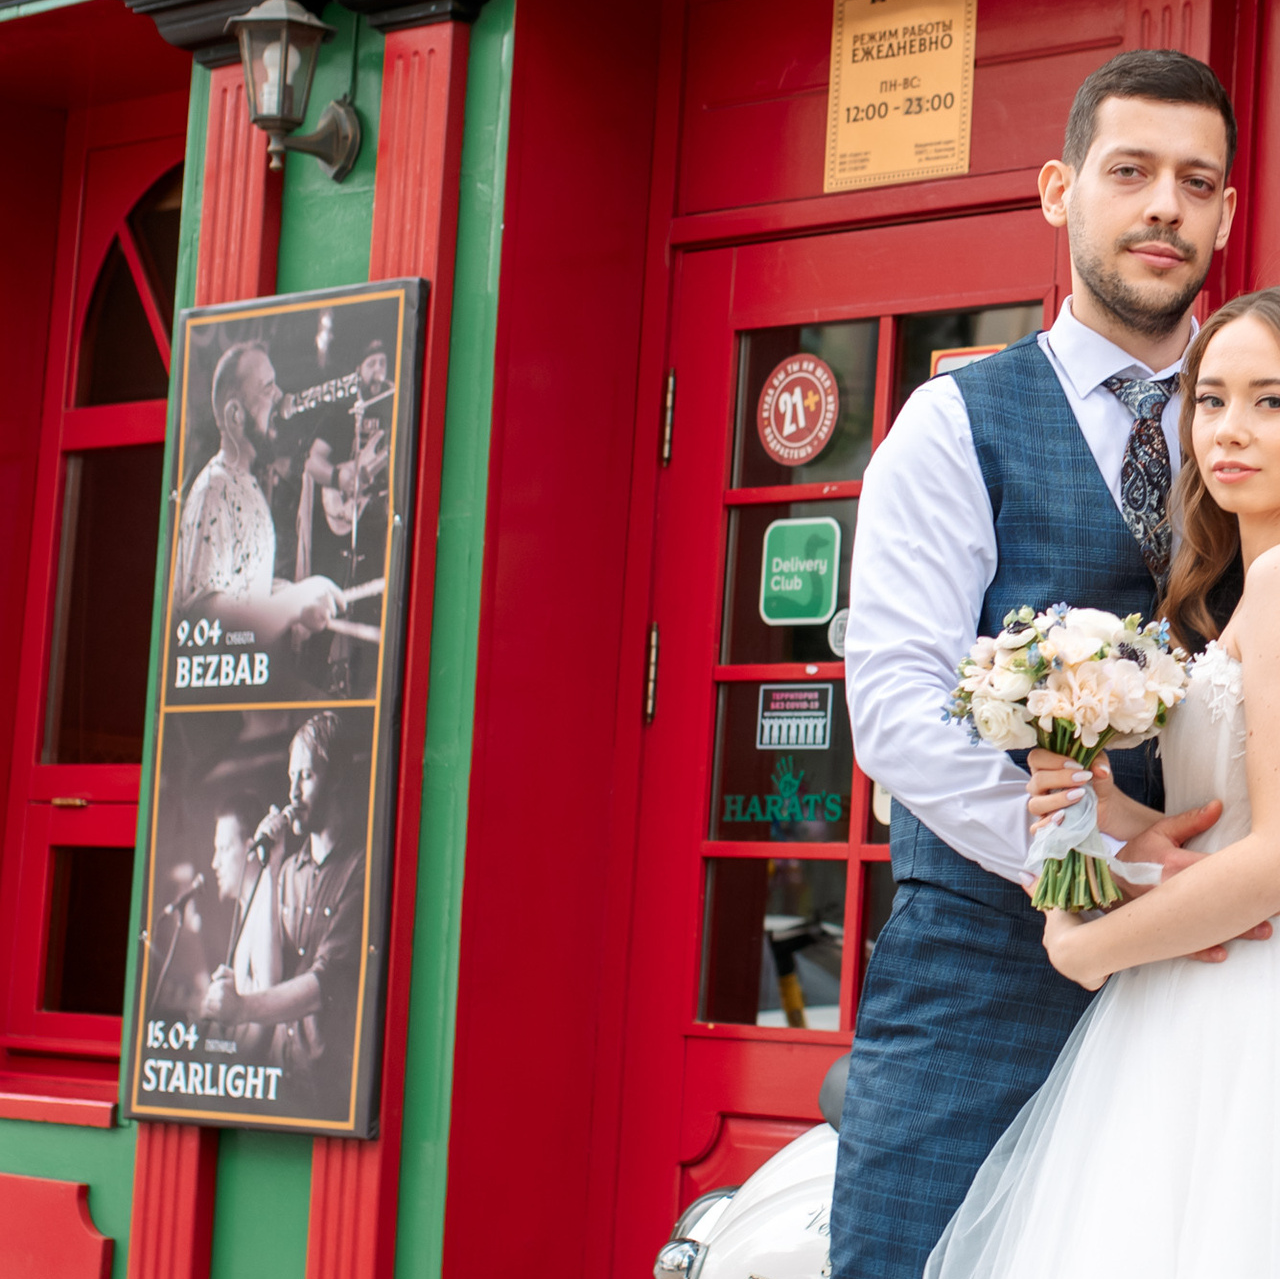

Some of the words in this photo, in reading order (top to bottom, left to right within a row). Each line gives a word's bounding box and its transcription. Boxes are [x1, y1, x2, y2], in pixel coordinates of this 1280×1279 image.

[851, 33, 953, 64] ЕЖЕДНЕВНО
[852, 28, 899, 47] РЕЖИМ
[902, 19, 953, 39] РАБОТЫ
[846, 102, 888, 124] 12:00
[904, 92, 955, 116] 23:00
[778, 386, 820, 438] 21+
[772, 556, 828, 575] Delivery
[770, 574, 803, 591] Club
[176, 618, 222, 647] 9.04
[174, 652, 270, 689] BEZBAB
[772, 691, 819, 701] ТЕРРИТОРИЯ
[723, 790, 842, 822] HARAT'S
[146, 1020, 199, 1051] 15.04
[142, 1057, 283, 1100] STARLIGHT
[805, 1203, 832, 1238] Ve
